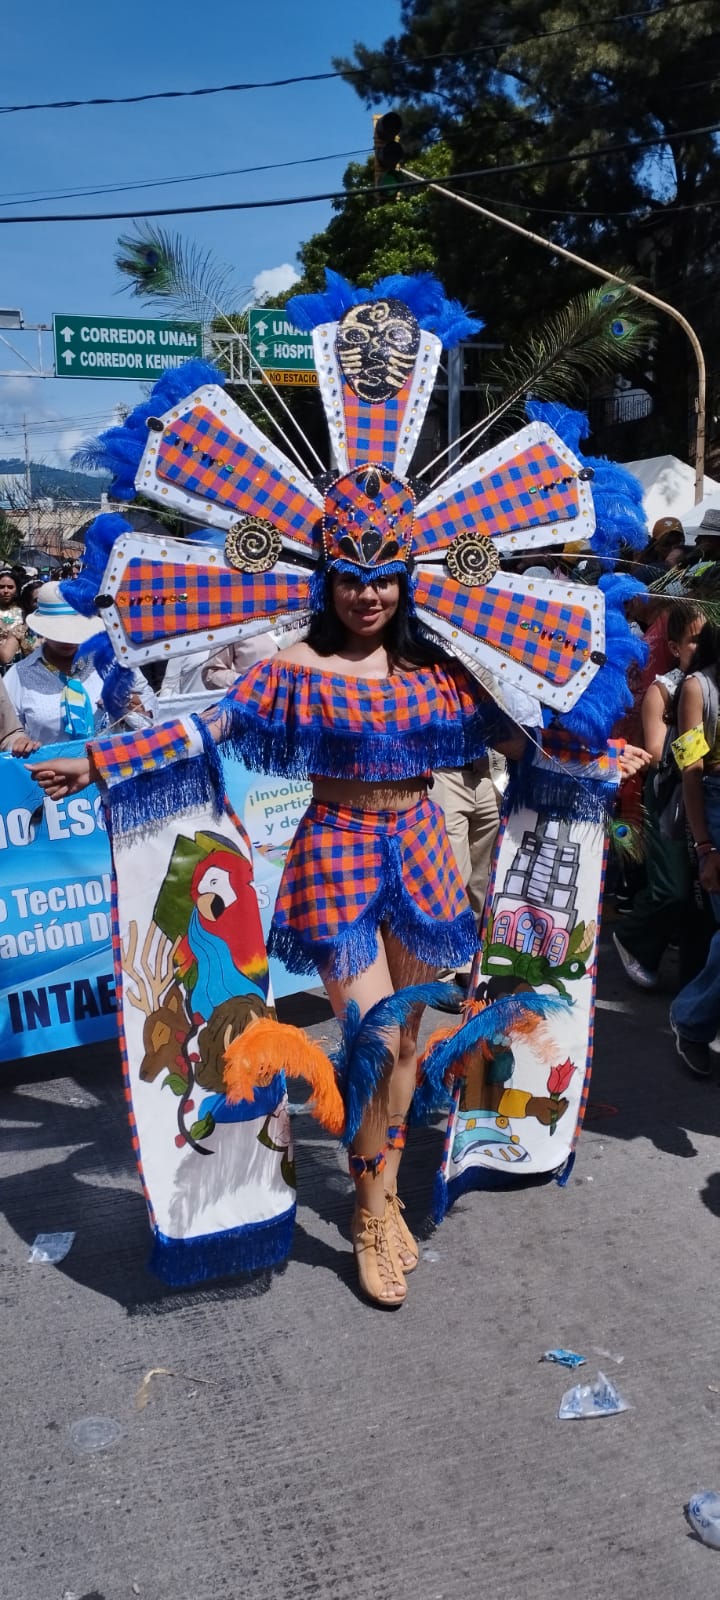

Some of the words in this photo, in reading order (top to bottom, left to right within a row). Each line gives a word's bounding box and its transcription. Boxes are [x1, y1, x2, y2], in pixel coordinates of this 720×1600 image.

[80, 327, 156, 345] CORREDOR
[159, 331, 197, 347] UNAH
[80, 351, 143, 368] CORREDOR
[145, 354, 191, 369] KENNE
[269, 373, 282, 381] NO
[283, 374, 317, 382] ESTACIO
[265, 823, 274, 836] y
[280, 816, 299, 829] de
[88, 911, 112, 943] D
[8, 973, 118, 1034] INTAE
